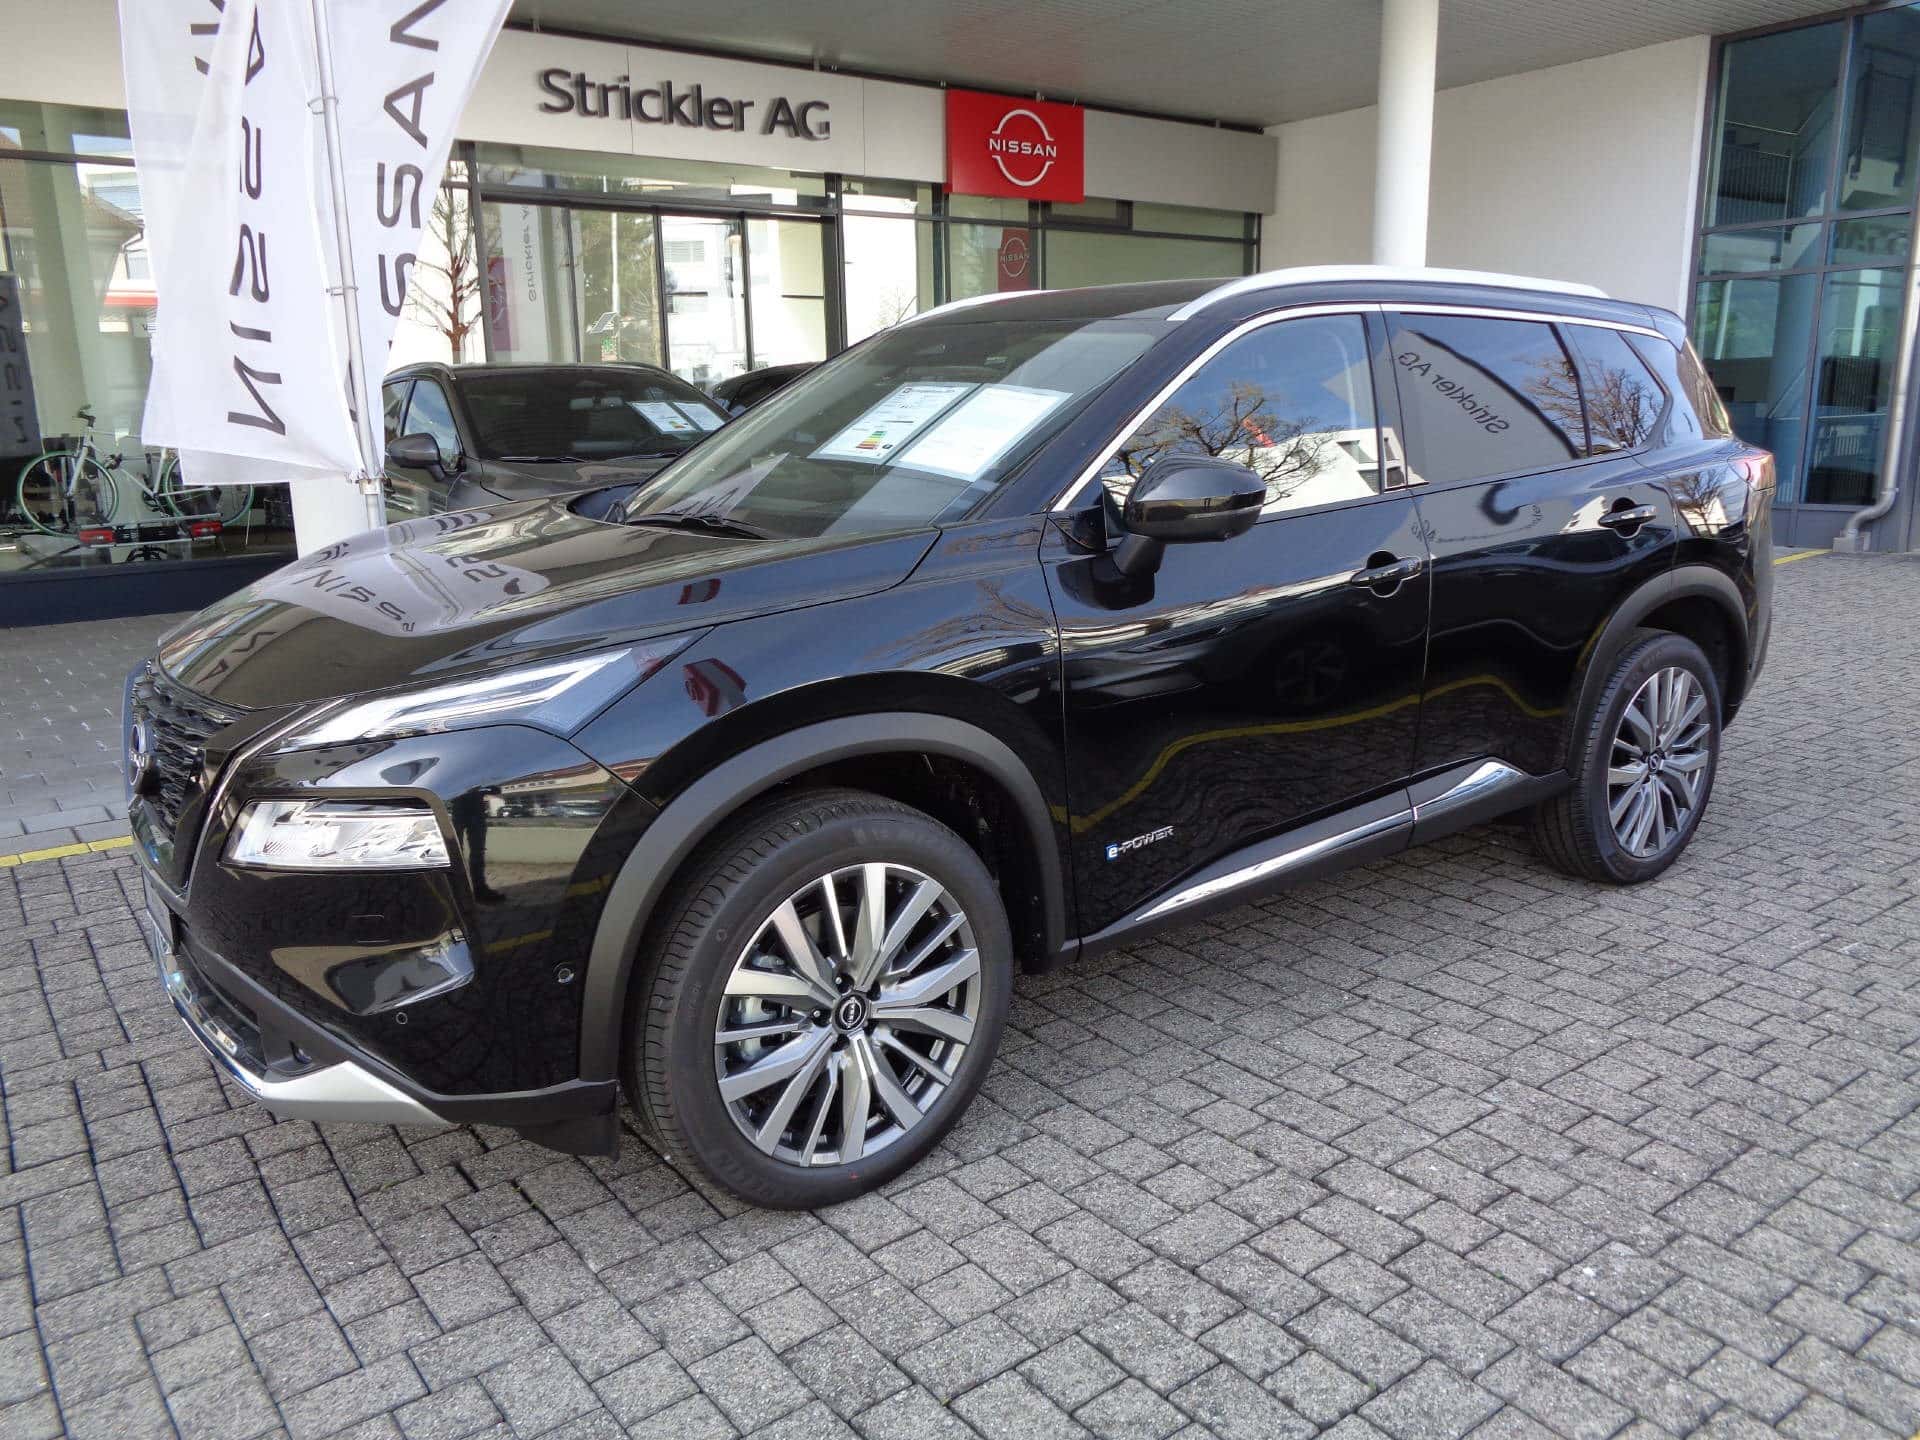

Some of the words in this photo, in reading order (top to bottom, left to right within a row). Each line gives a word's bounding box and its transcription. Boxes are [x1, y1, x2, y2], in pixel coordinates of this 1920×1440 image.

[539, 68, 754, 132] Strickler
[760, 97, 831, 141] AG
[989, 138, 1057, 157] NISSAN
[1107, 825, 1174, 859] e-POWER
